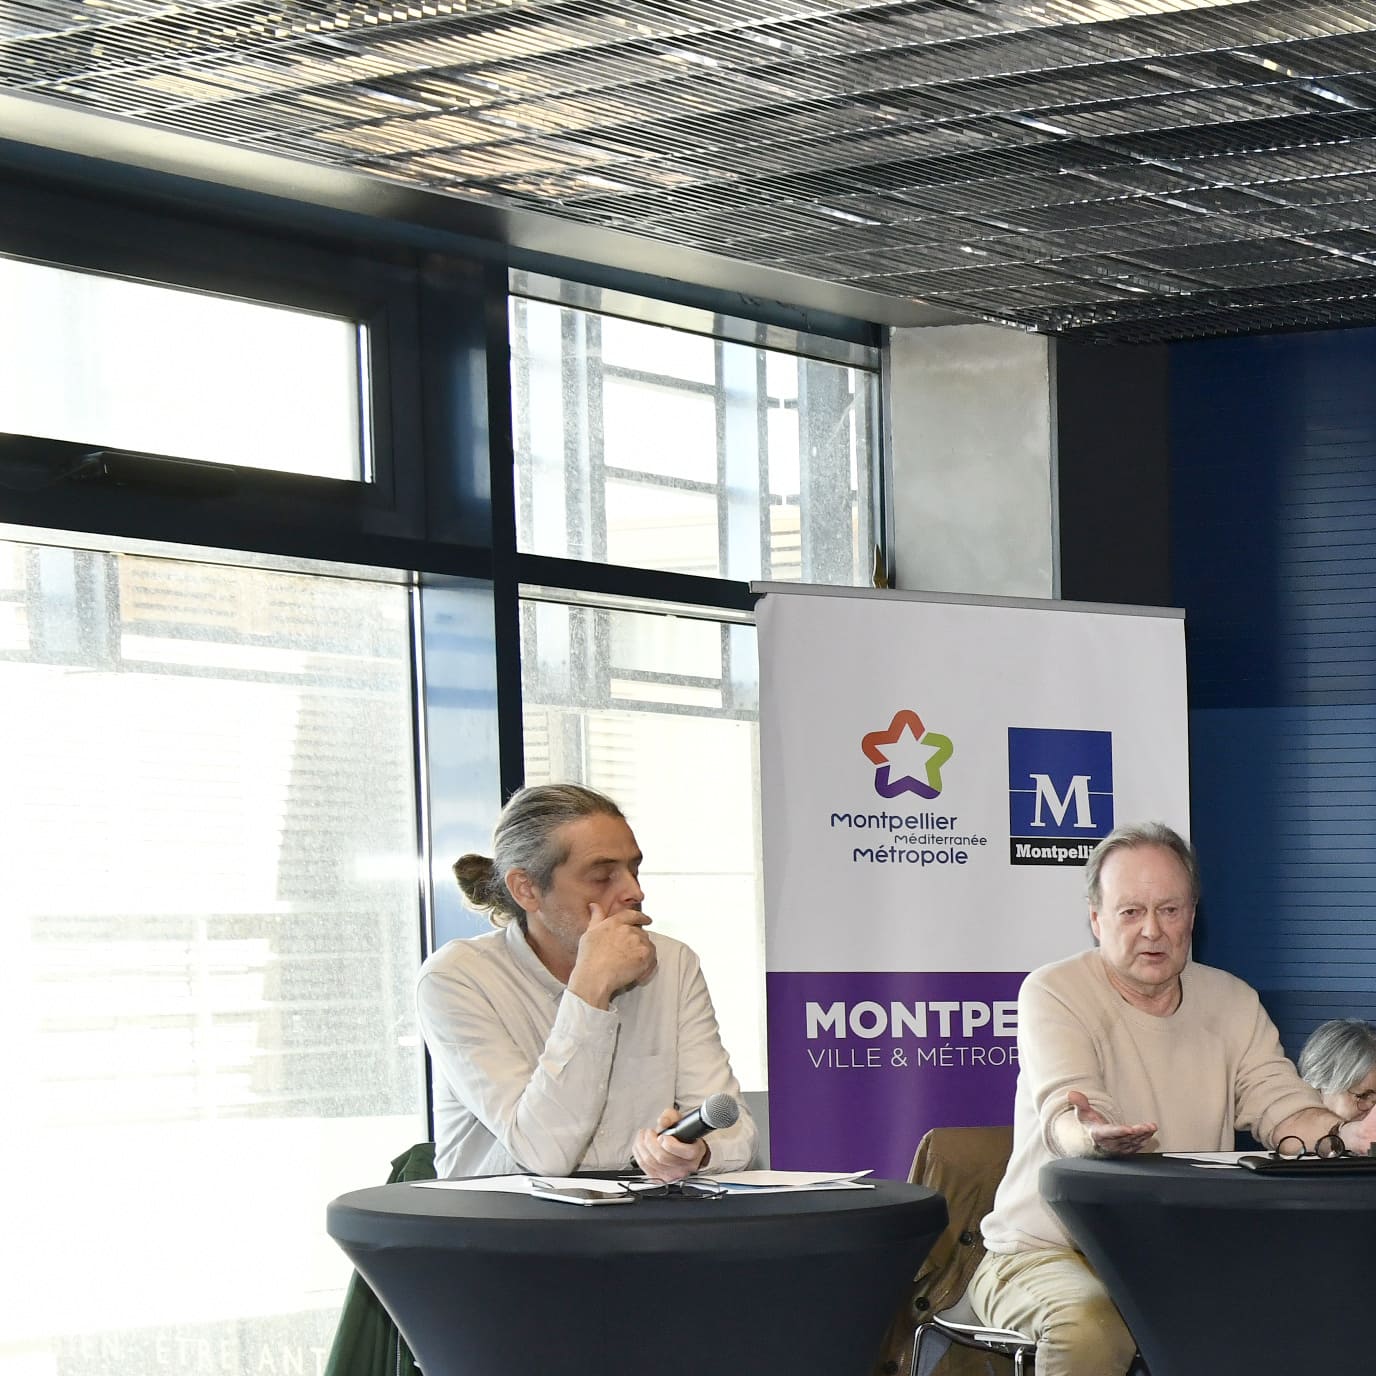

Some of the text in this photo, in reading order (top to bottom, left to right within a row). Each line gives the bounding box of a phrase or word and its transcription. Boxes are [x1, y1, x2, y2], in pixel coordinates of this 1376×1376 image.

[1015, 843, 1094, 862] Montpelli
[805, 1000, 1019, 1040] MONTPE
[808, 1042, 1019, 1069] VILLE & MÉTROP
